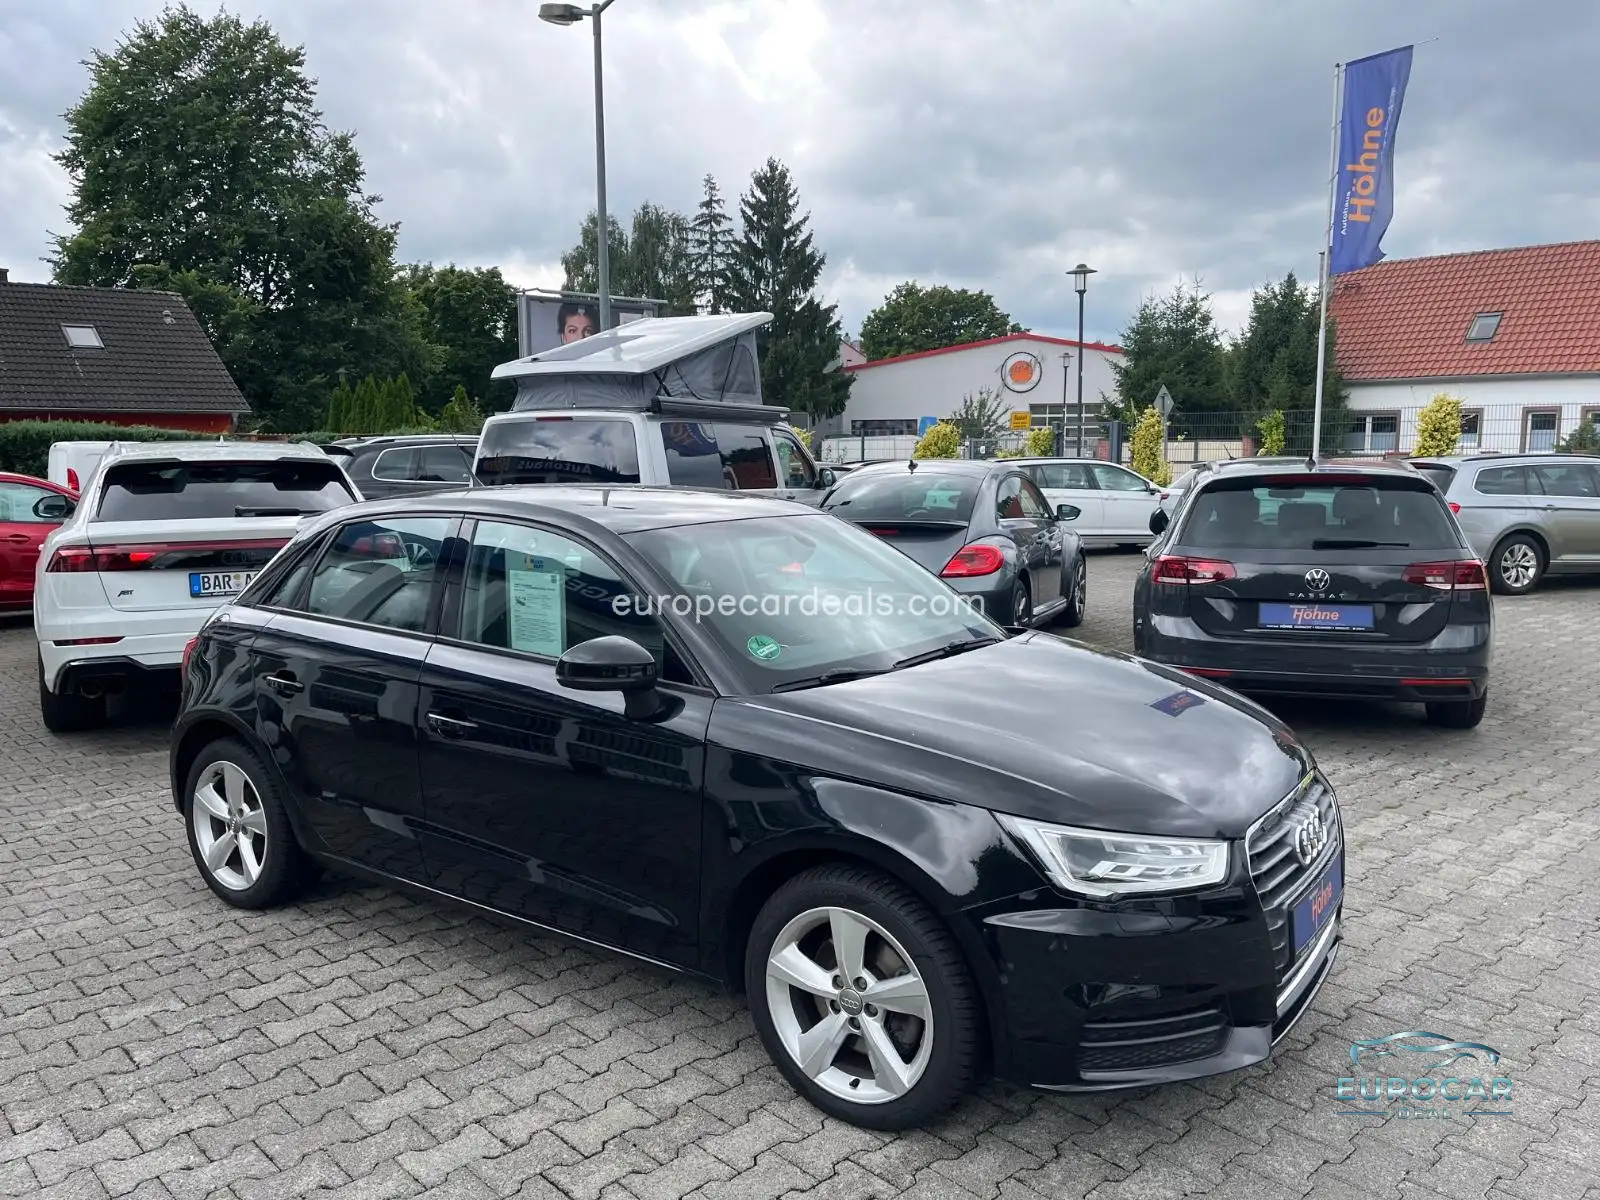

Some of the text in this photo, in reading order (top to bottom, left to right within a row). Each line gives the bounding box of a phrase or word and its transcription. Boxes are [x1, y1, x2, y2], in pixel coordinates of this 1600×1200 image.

[1345, 107, 1385, 223] Höhne
[1340, 191, 1351, 236] Autohaus
[201, 574, 232, 591] BAR
[1292, 605, 1340, 625] Höhne
